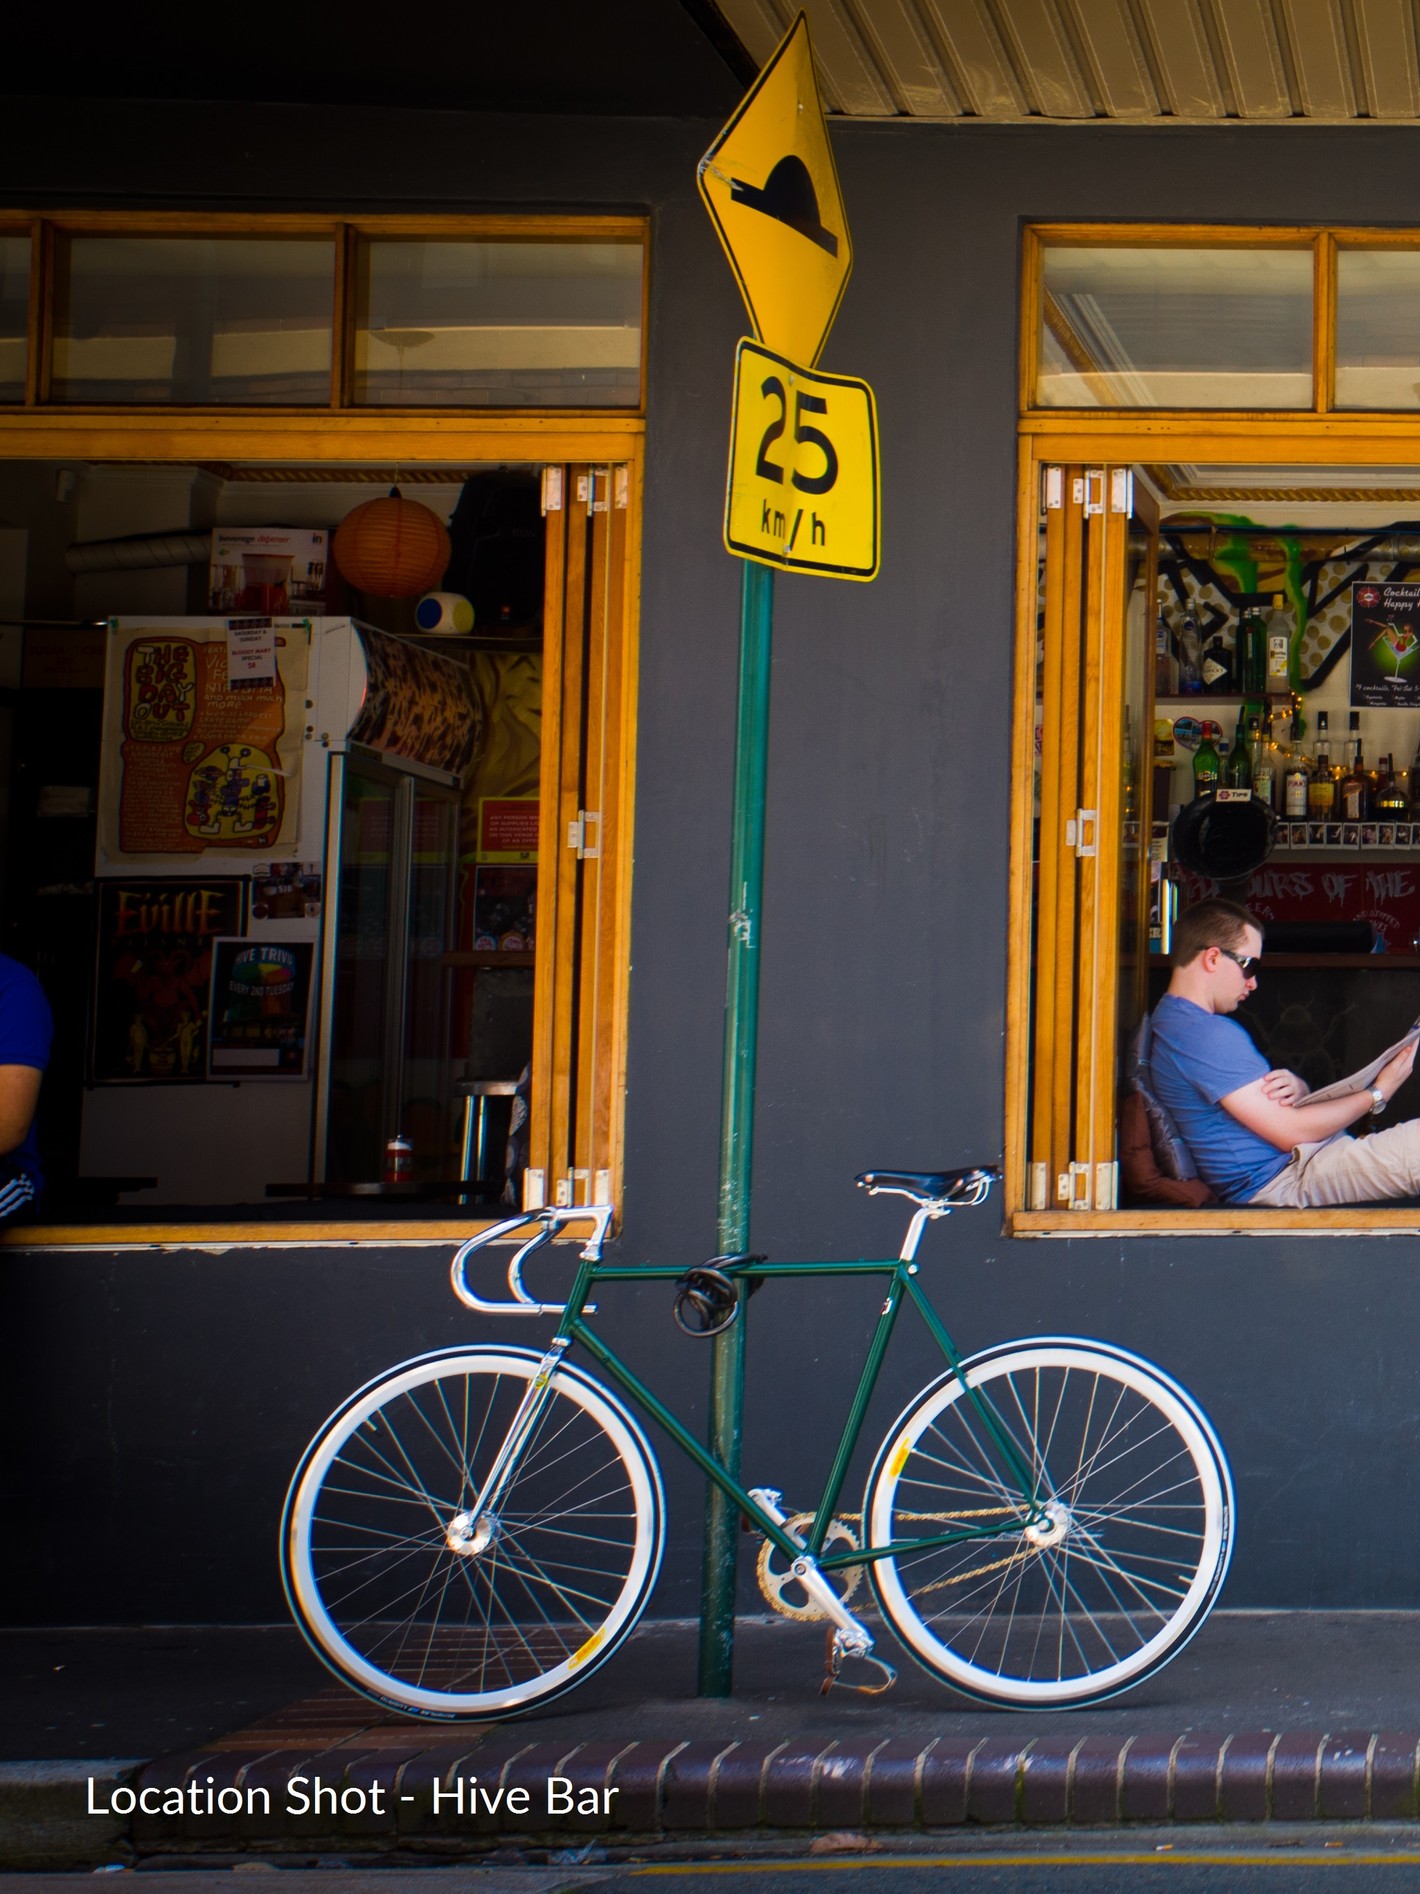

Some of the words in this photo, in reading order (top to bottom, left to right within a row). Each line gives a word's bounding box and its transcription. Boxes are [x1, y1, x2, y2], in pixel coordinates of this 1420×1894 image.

[756, 376, 838, 495] 25
[761, 499, 825, 551] km/h
[312, 532, 322, 543] in
[1383, 598, 1414, 611] Happy
[136, 644, 191, 665] THE
[136, 663, 188, 683] BIG
[139, 682, 195, 703] DAY
[134, 701, 191, 721] OUT
[1321, 871, 1358, 906] OF
[1365, 870, 1415, 906] THE
